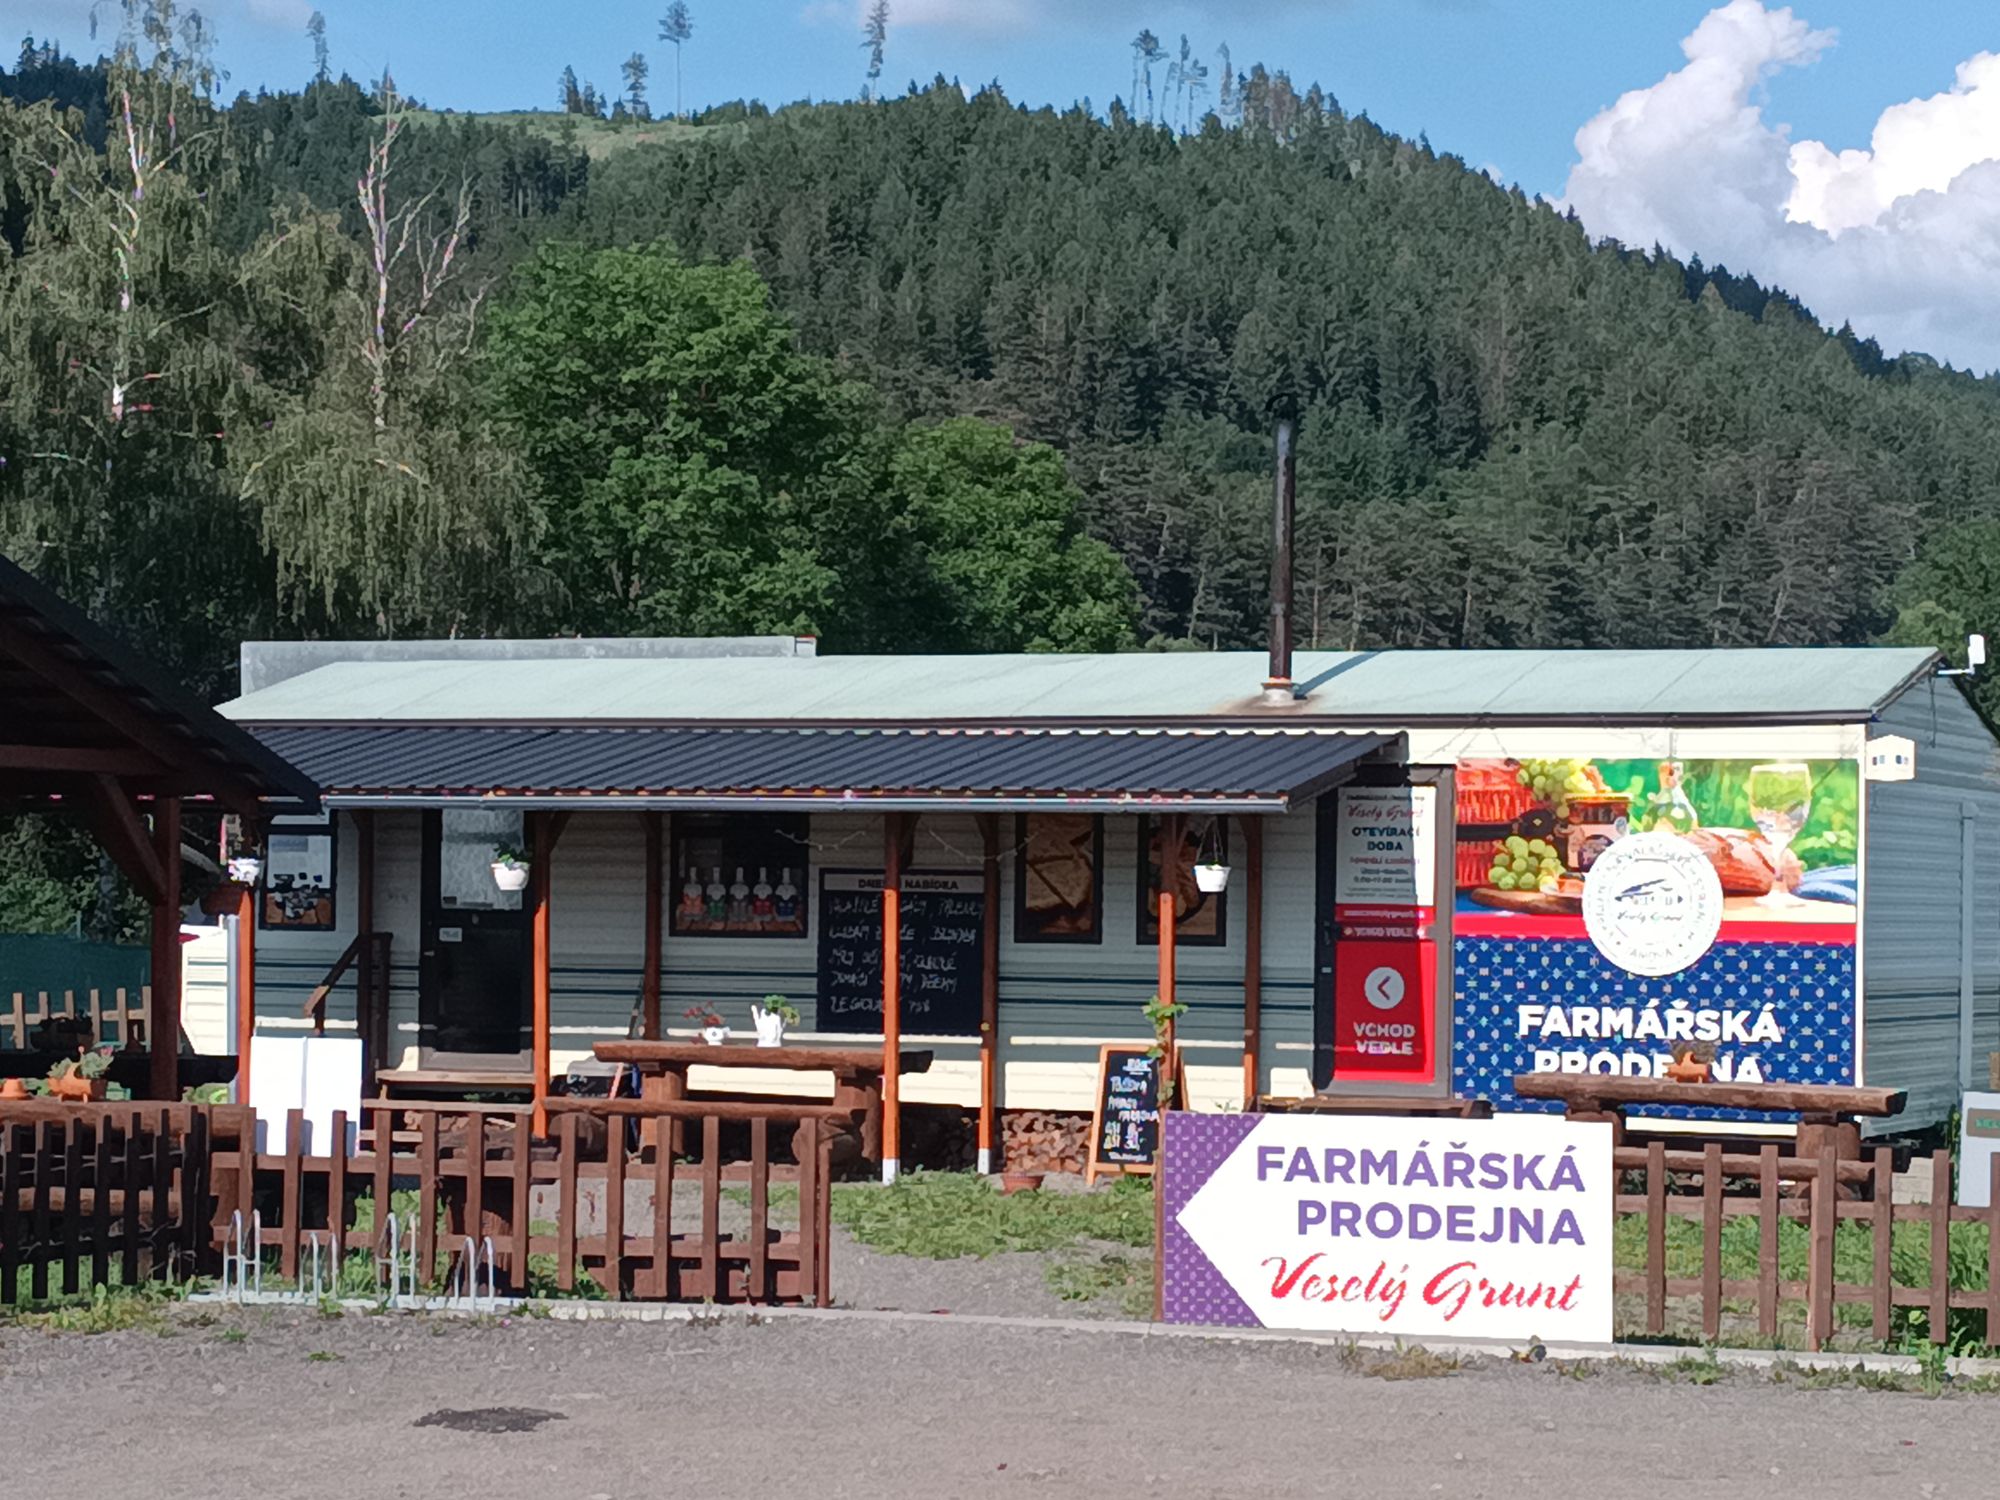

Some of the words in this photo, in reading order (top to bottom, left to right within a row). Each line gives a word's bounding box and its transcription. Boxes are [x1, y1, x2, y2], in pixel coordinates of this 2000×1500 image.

[1367, 841, 1403, 851] DOBA
[1353, 1021, 1416, 1037] VCHOD
[1518, 999, 1782, 1043] FARMÁŘSKÁ
[1355, 1040, 1414, 1055] VEDLE
[1534, 1050, 1764, 1083] PRODENA
[1257, 1140, 1586, 1192] FARMÁŘSKÁ
[1297, 1200, 1586, 1245] PRODEJNA
[1261, 1252, 1410, 1322] Veselý
[1423, 1261, 1585, 1322] Grunt
